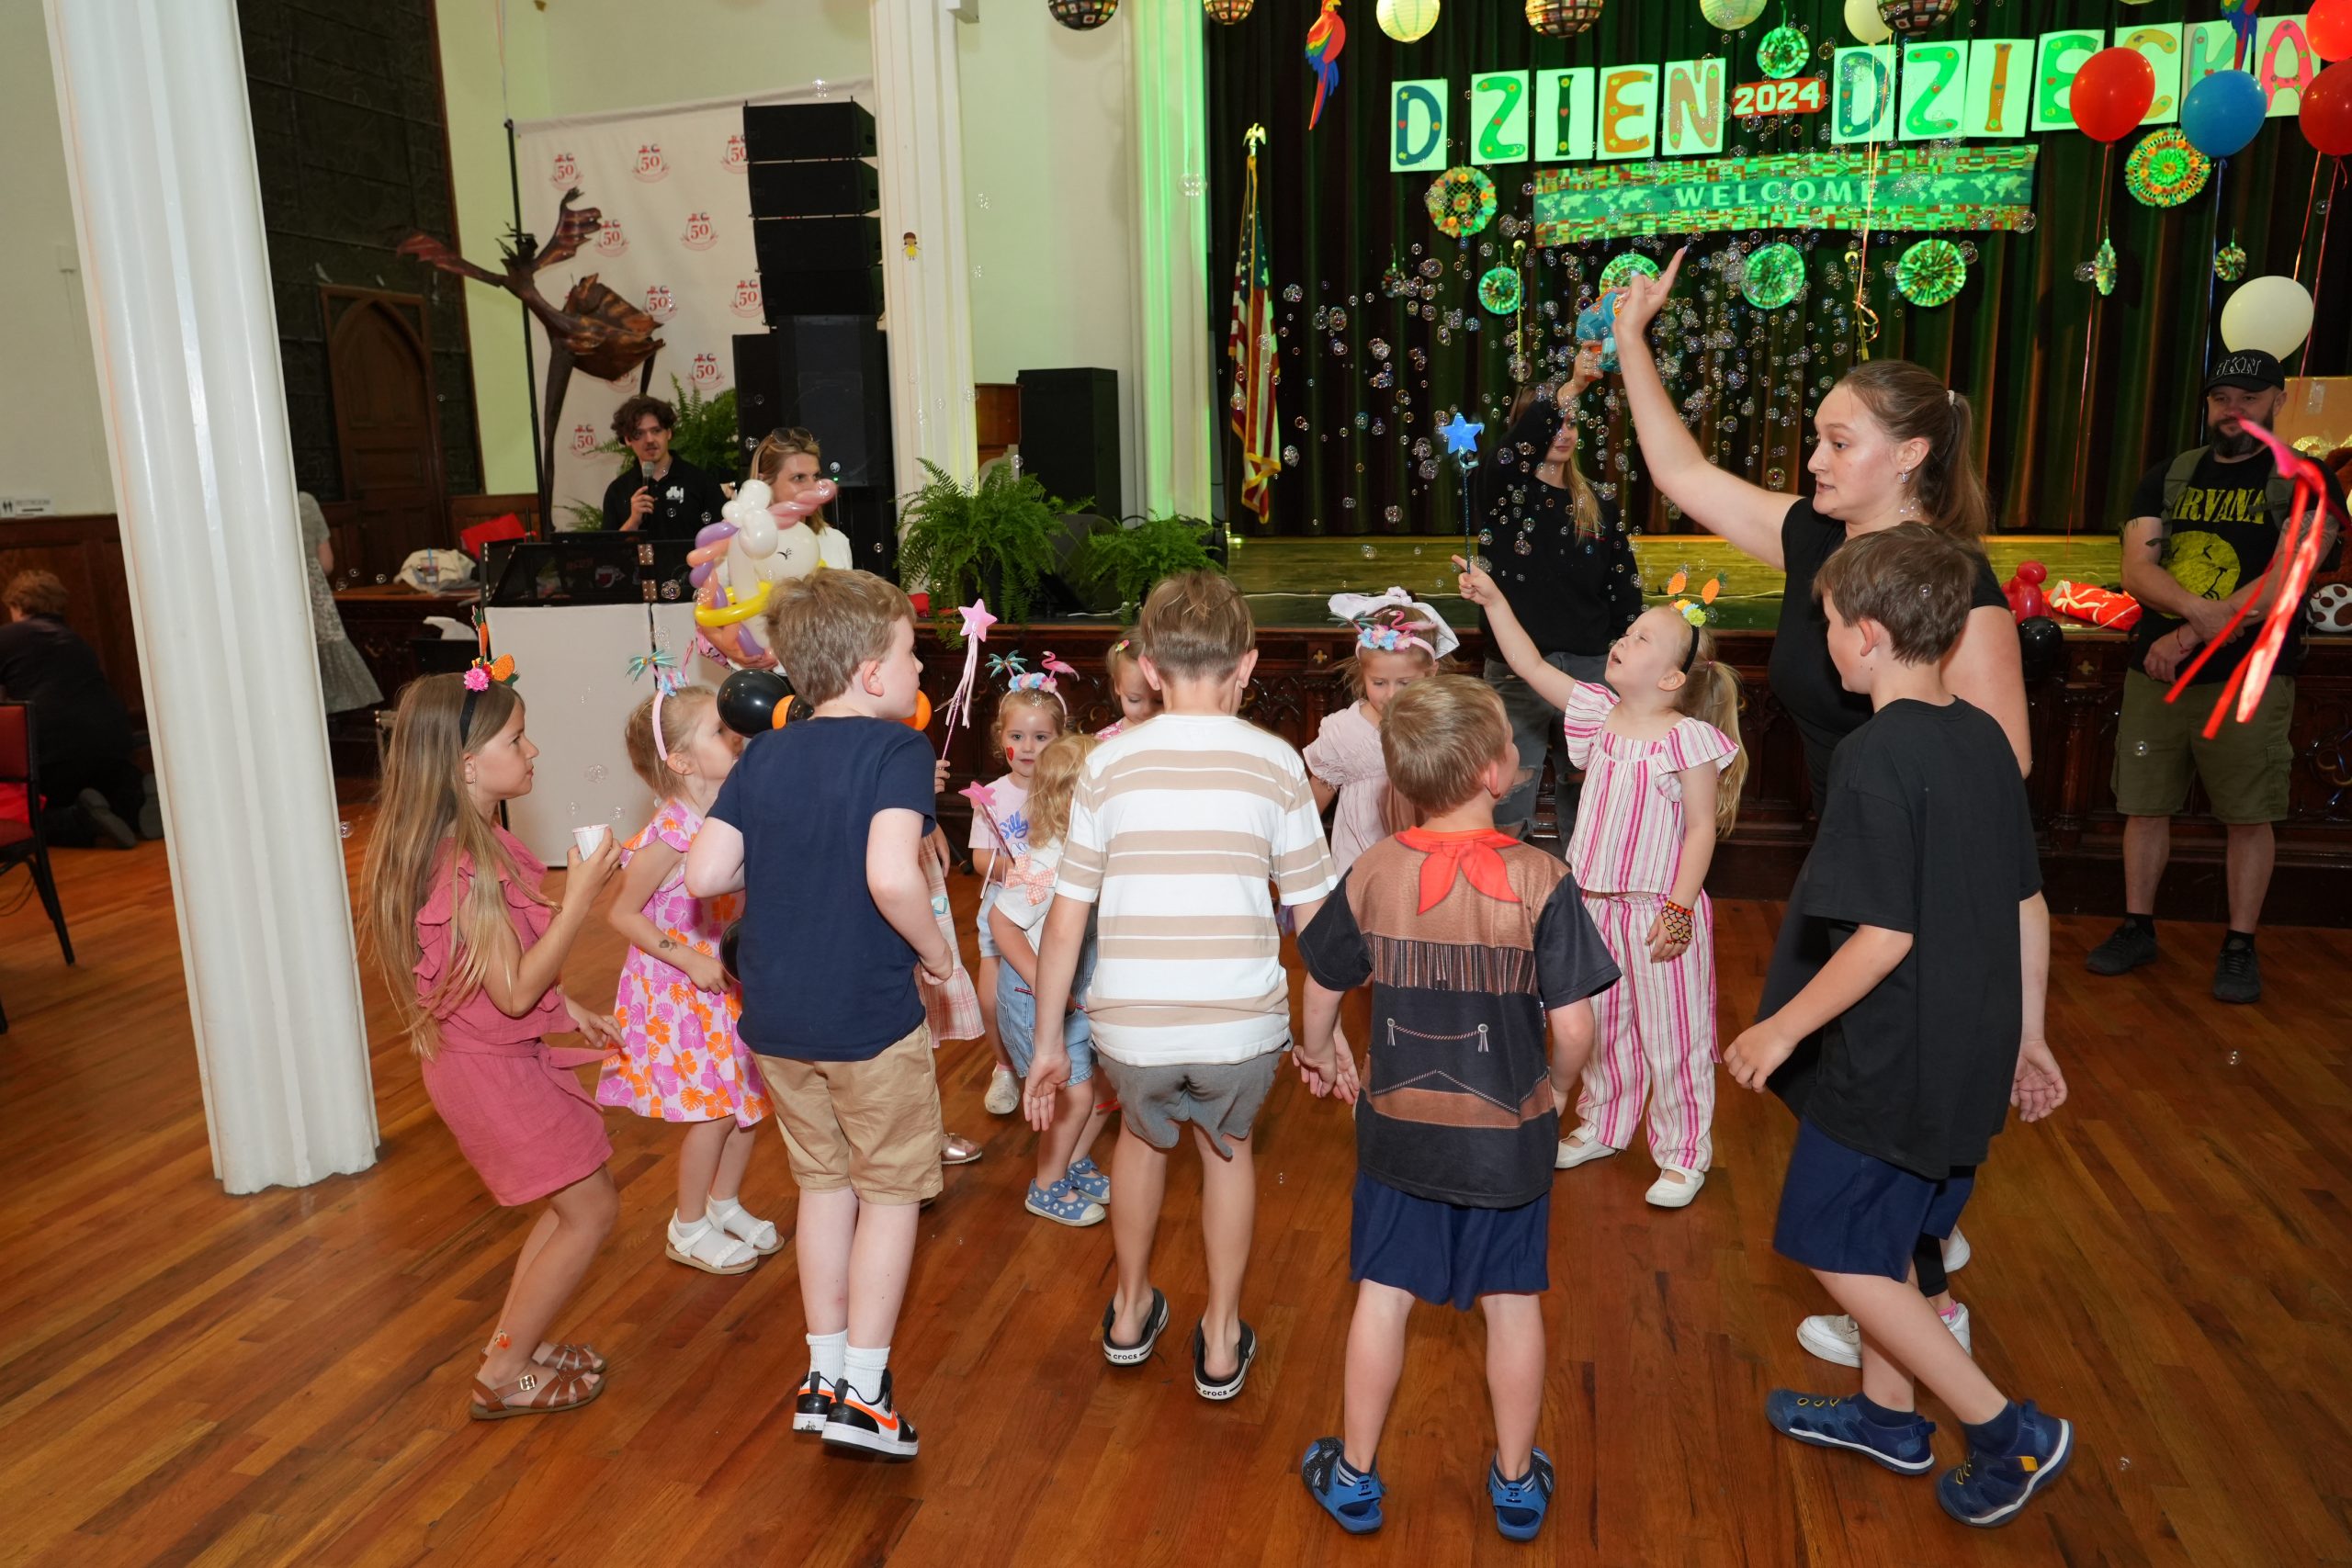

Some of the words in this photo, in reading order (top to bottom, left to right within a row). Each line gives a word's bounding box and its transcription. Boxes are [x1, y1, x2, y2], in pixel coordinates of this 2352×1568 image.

[1733, 80, 1821, 116] 2024
[558, 164, 574, 180] 50
[640, 156, 661, 172] 50
[1674, 180, 1879, 208] WELCOME
[603, 231, 621, 245] 50
[690, 223, 709, 240] 50
[649, 297, 668, 311] 50
[739, 291, 758, 306] 50
[695, 364, 716, 378] 50
[577, 434, 594, 449] 50
[2170, 486, 2267, 525] IRVANA
[999, 810, 1029, 840] Silly
